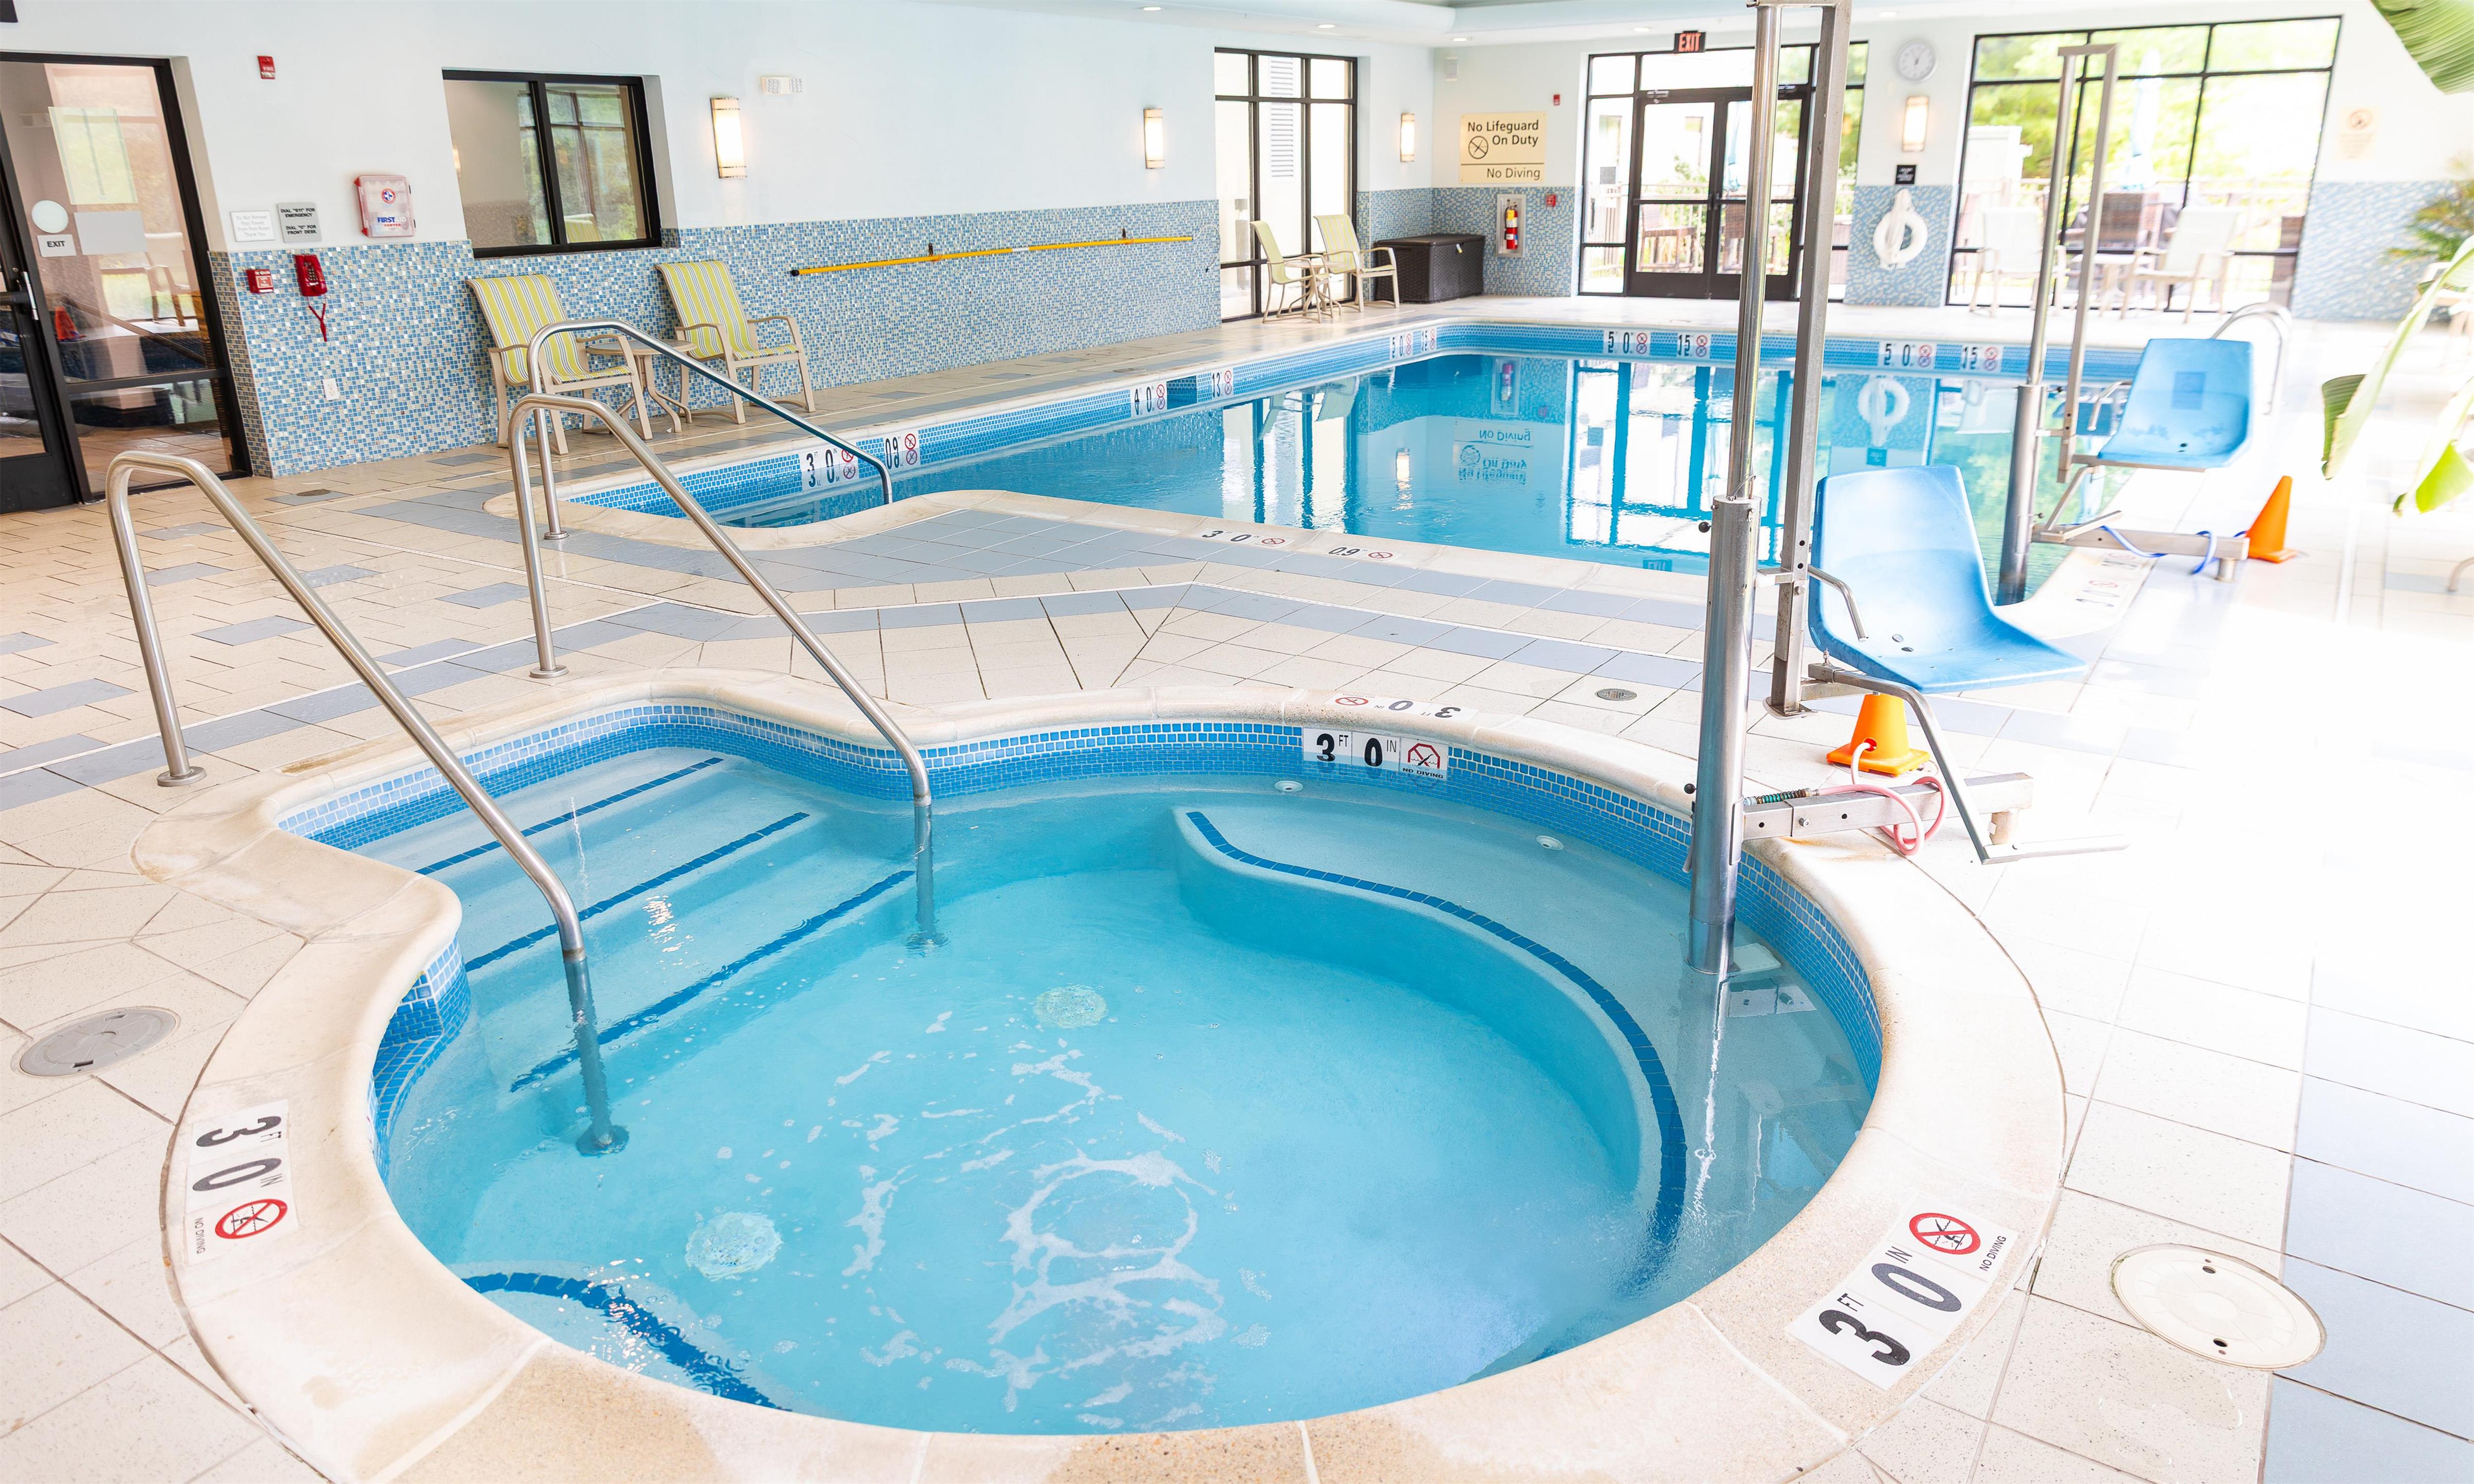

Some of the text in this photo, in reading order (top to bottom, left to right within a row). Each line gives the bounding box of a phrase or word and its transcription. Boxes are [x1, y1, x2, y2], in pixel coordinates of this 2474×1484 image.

[1678, 32, 1701, 52] EXIT
[1468, 120, 1539, 134] No Lifeguard
[1492, 134, 1539, 147] On Duty
[1487, 167, 1540, 181] No Diving
[1328, 547, 1361, 556] 0.9
[1389, 700, 1413, 711] 0
[1434, 706, 1461, 718] 3
[1316, 733, 1396, 767] 3 FT 0 IN
[1416, 770, 1444, 779] DIVING
[192, 1116, 283, 1192] 3 FT 0 IN
[195, 1217, 206, 1254] NO DIVING
[1979, 1236, 2007, 1271] NO DIVING
[1819, 1245, 1962, 1367] 3 FT 0 IN
